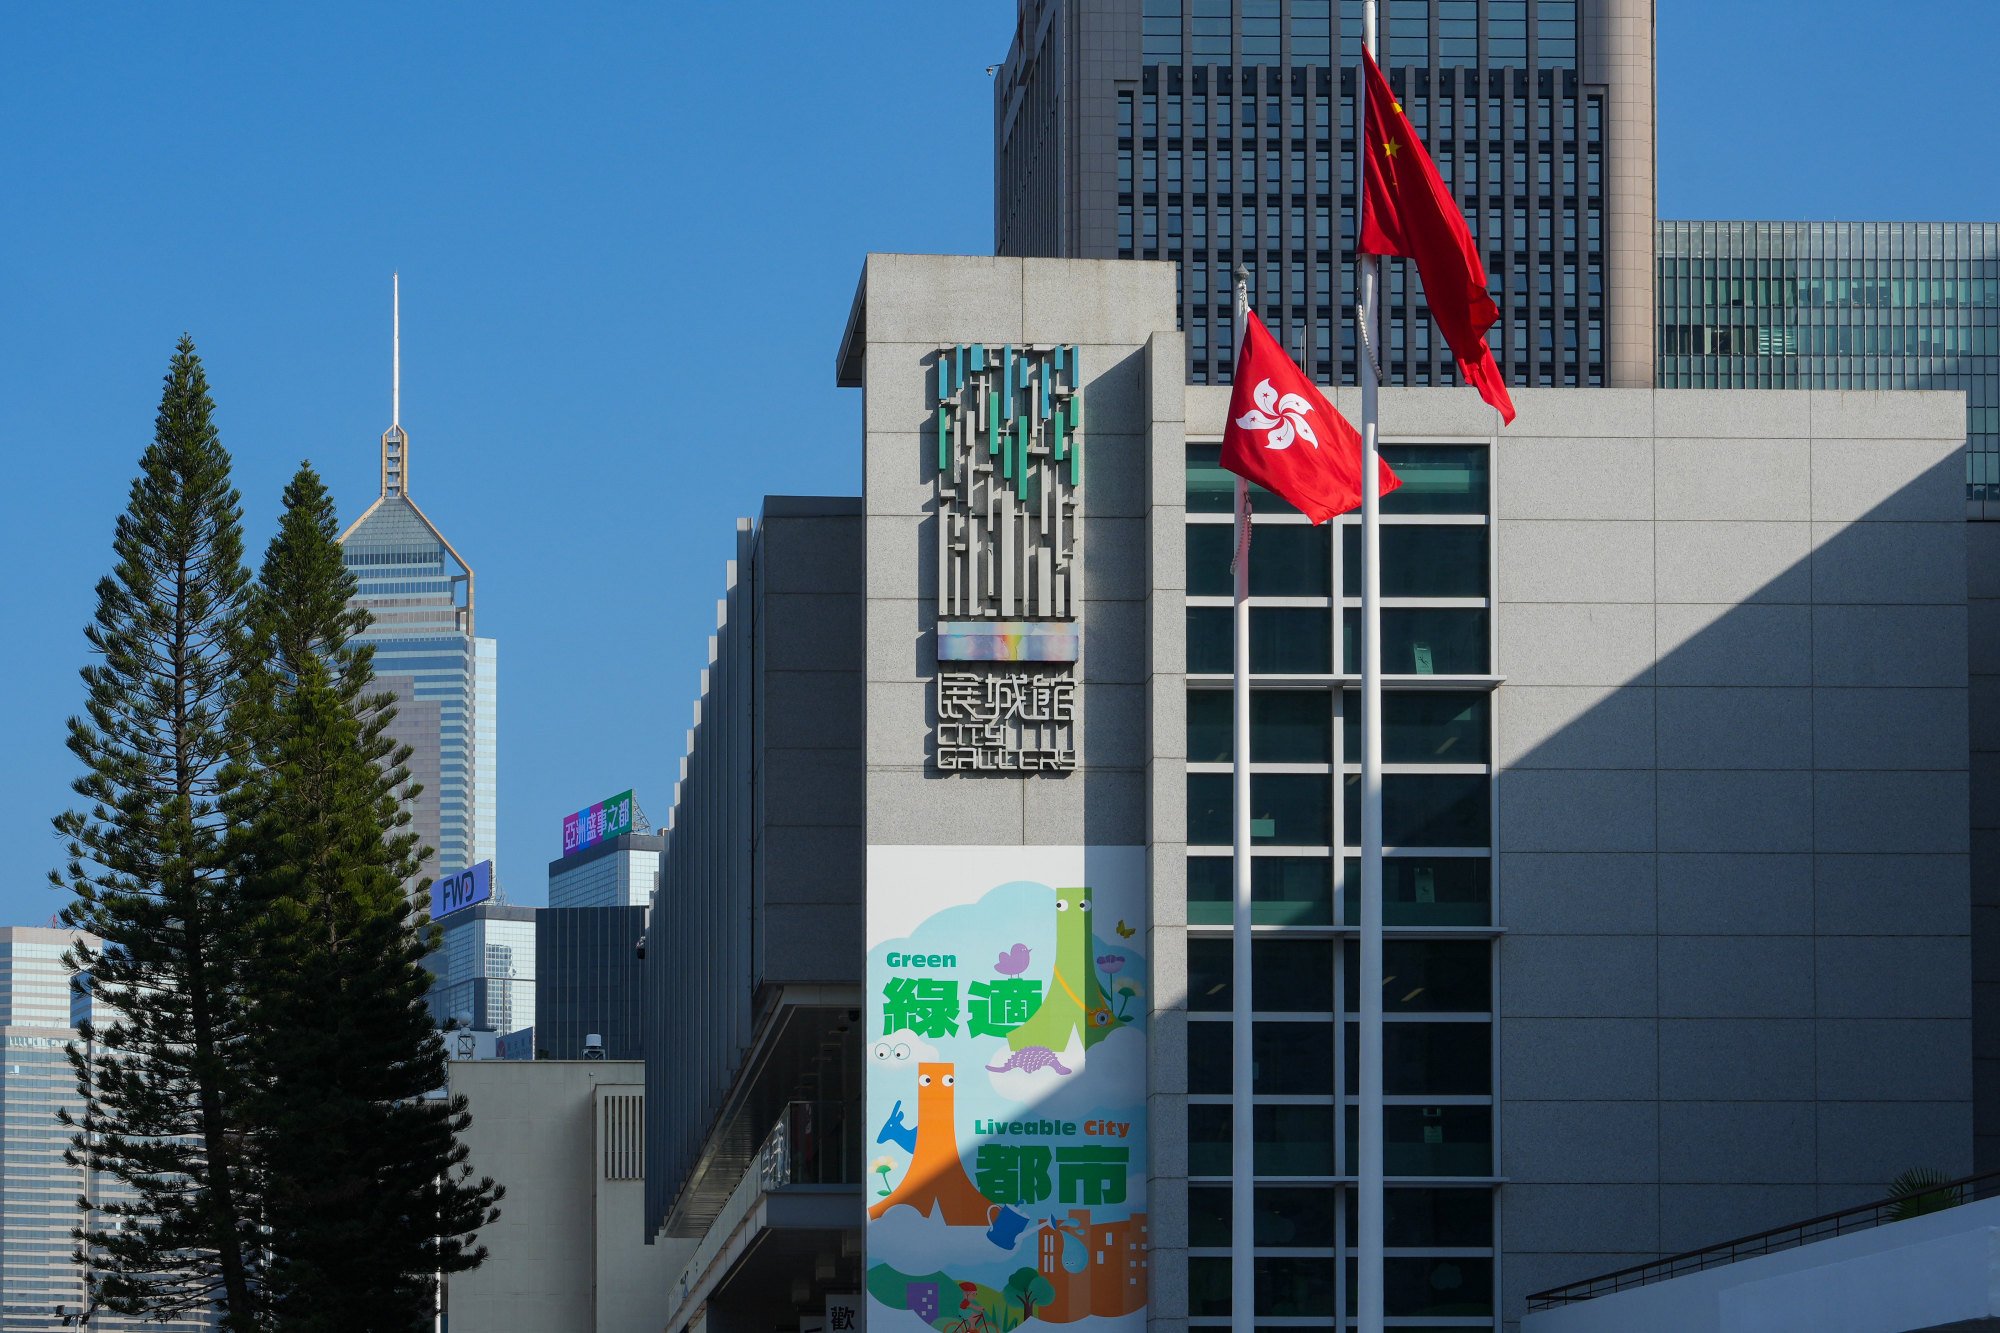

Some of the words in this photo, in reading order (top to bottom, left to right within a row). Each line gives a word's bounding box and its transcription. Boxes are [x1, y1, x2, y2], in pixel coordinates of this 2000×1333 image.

[937, 747, 1078, 769] GALLERY
[565, 798, 630, 851] 亞洲盛事之都
[443, 870, 475, 912] FWD
[886, 952, 957, 968] Green
[974, 1119, 1077, 1136] Liveable
[1083, 1120, 1131, 1138] City
[975, 1143, 1130, 1206] 都市
[830, 1306, 856, 1331] 歡
